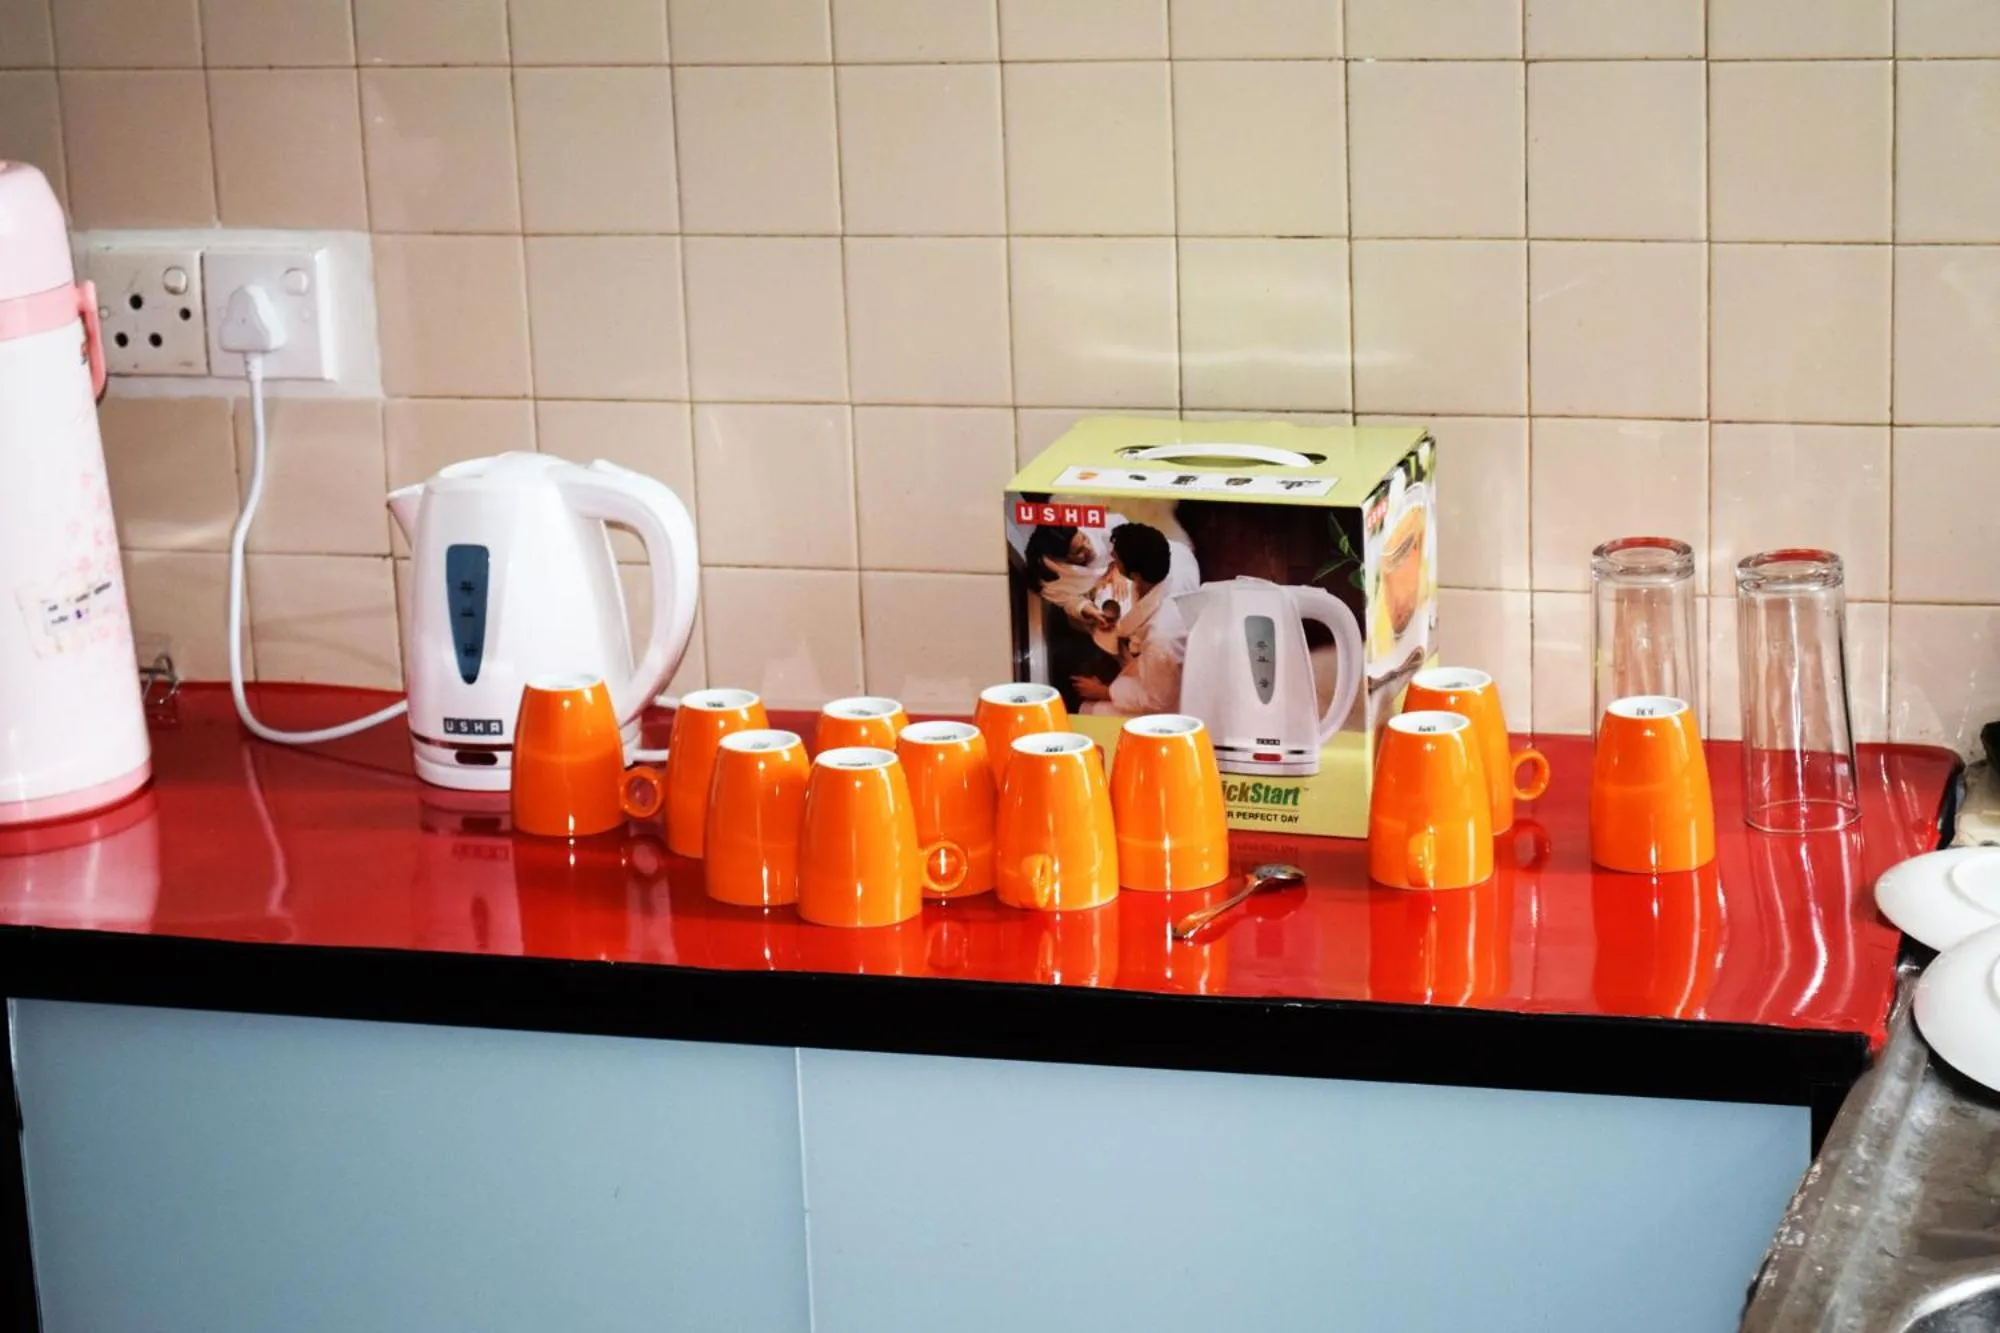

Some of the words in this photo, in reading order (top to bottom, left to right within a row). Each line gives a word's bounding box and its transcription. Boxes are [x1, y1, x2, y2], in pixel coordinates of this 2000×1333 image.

[1019, 505, 1102, 525] USHA
[445, 720, 501, 733] USHA
[1222, 780, 1300, 806] ickStart
[1236, 811, 1279, 822] PERFECT
[1280, 814, 1300, 824] DAY
